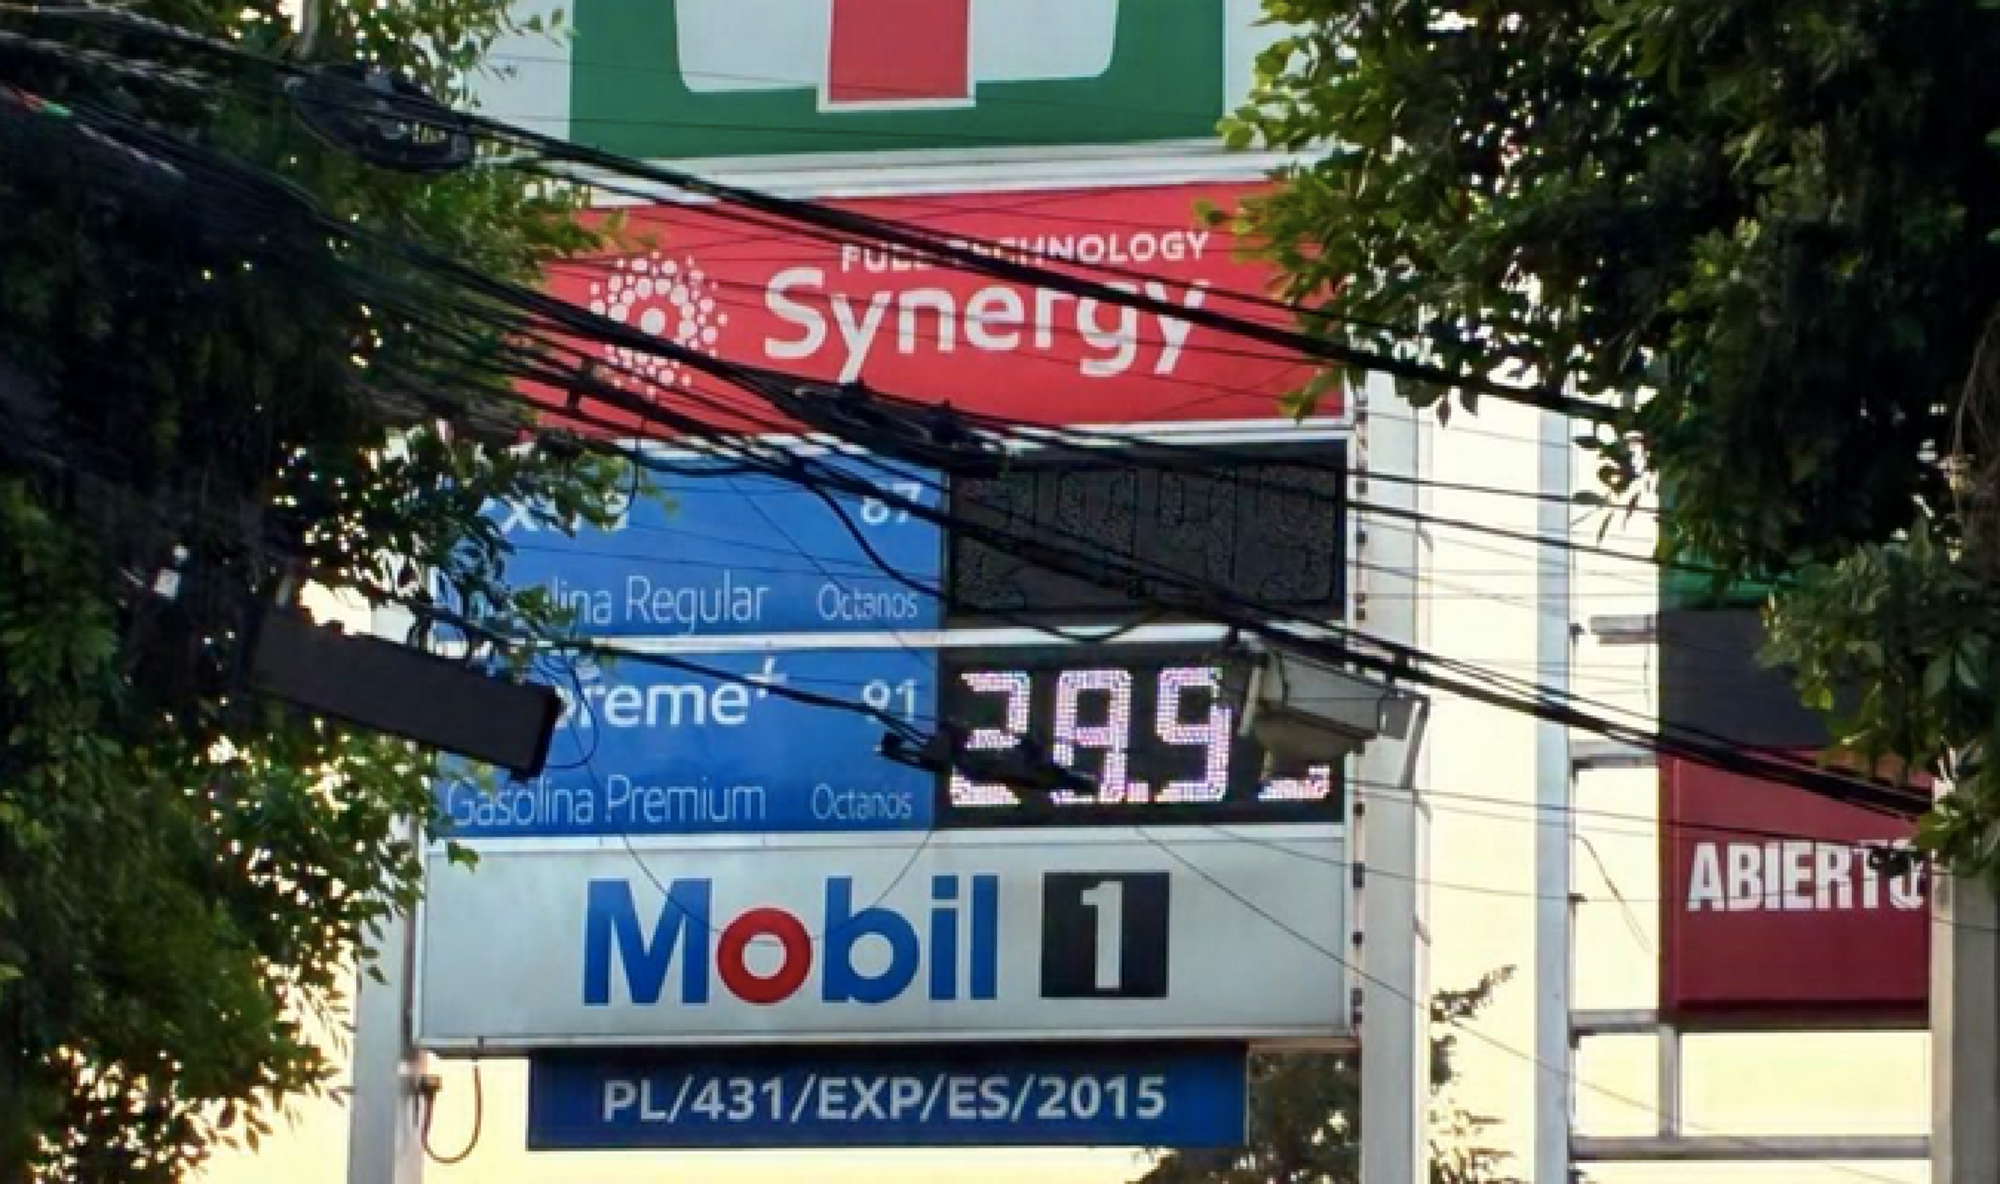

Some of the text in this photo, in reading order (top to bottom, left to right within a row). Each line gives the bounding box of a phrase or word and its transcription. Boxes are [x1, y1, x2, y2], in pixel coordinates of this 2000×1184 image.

[764, 266, 1210, 384] Synergy
[625, 569, 770, 635] Regular
[815, 581, 918, 621] Octanos
[447, 773, 767, 826] Gasolina Premium
[811, 783, 914, 821] Octanos
[583, 873, 998, 1006] Mobil
[603, 1073, 1168, 1123] PL/431/EXP/ES/2015
